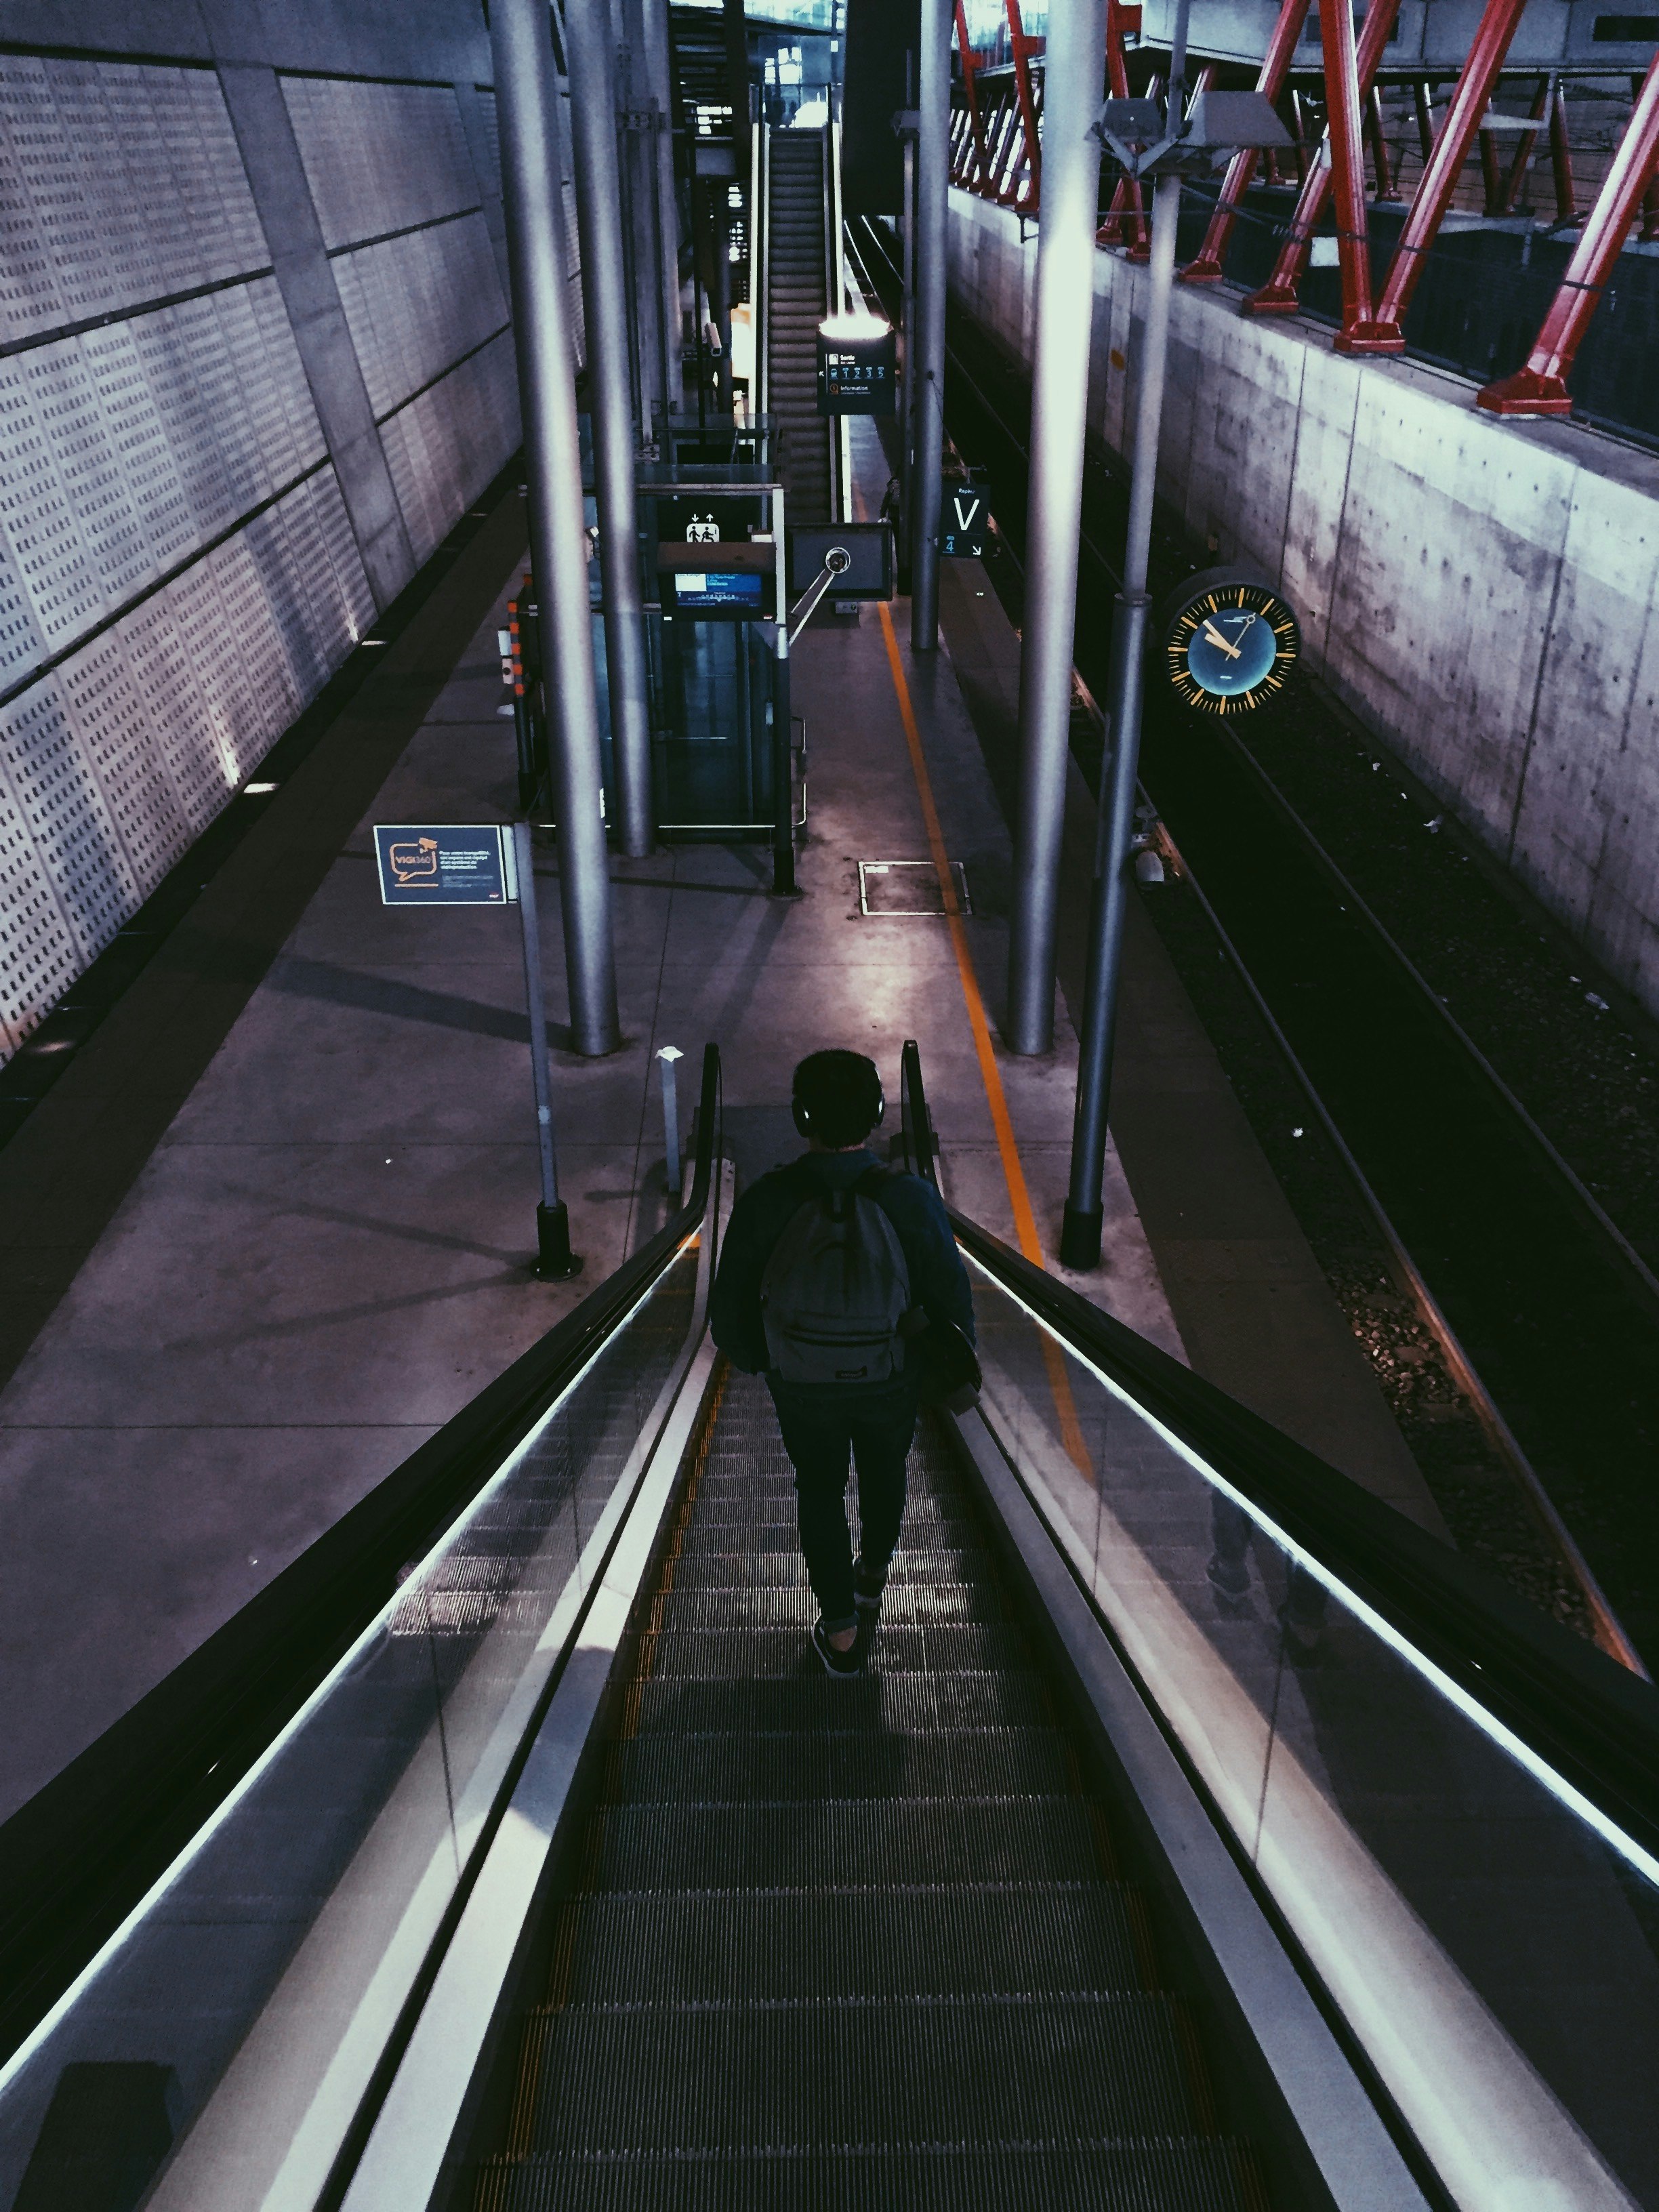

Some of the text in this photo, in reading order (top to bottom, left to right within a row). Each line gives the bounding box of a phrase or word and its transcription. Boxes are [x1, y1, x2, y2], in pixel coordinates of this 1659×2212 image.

[855, 370, 860, 378] 2
[954, 498, 980, 530] V
[946, 541, 954, 552] 4
